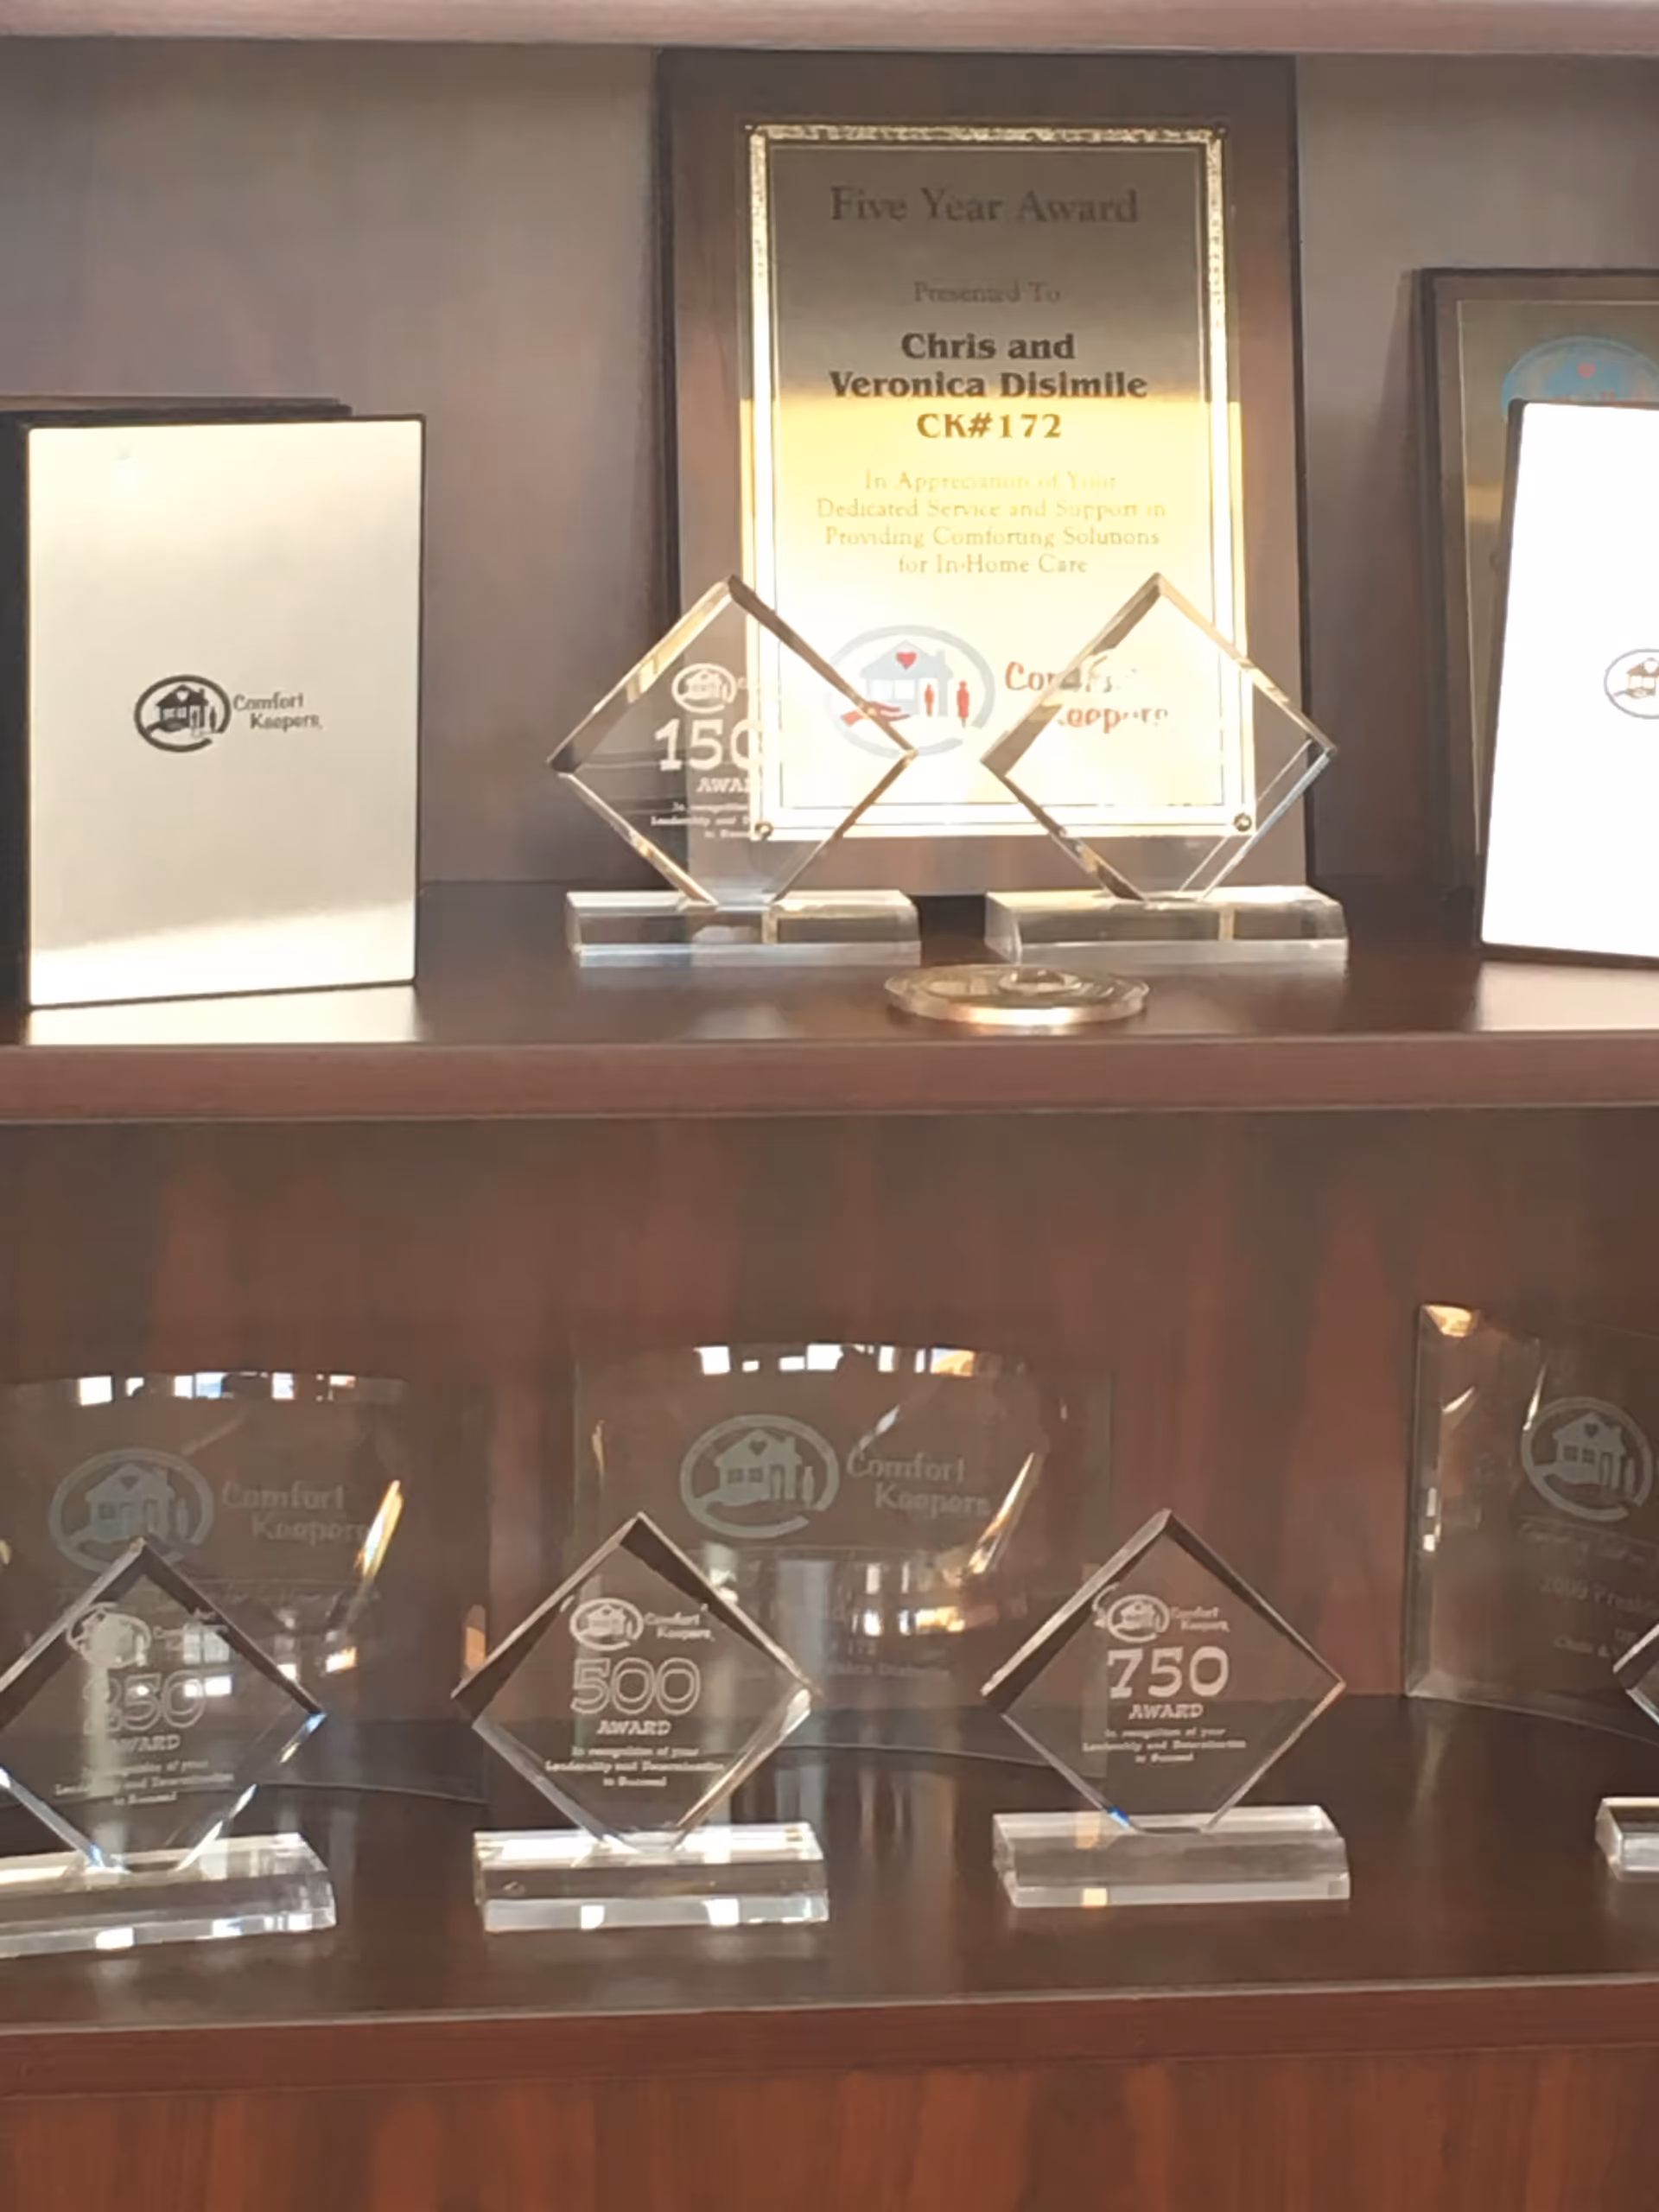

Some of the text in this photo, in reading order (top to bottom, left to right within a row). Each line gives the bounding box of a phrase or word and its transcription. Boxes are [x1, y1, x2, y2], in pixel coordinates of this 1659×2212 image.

[830, 186, 1140, 223] Five Year Award
[913, 281, 1061, 303] Presented To
[901, 333, 1076, 360] Chris and
[829, 371, 1148, 399] Veronica Disimile
[916, 412, 1062, 439] CK#172
[816, 497, 918, 518] Dedicated
[926, 498, 1001, 518] Service
[1009, 499, 1046, 518] and
[1055, 499, 1139, 522] Support
[824, 524, 1161, 549] Providing Comforting Solutions
[898, 553, 929, 574] for
[1037, 554, 1090, 574] Care
[232, 691, 304, 711] Comfort
[695, 777, 762, 793] AWA
[221, 1480, 345, 1510] Comfort
[1106, 1645, 1229, 1700] 750
[569, 1656, 701, 1715] 500
[1128, 1703, 1205, 1720] AWARD
[596, 1719, 671, 1736] AWARD
[109, 1734, 181, 1753] WARD
